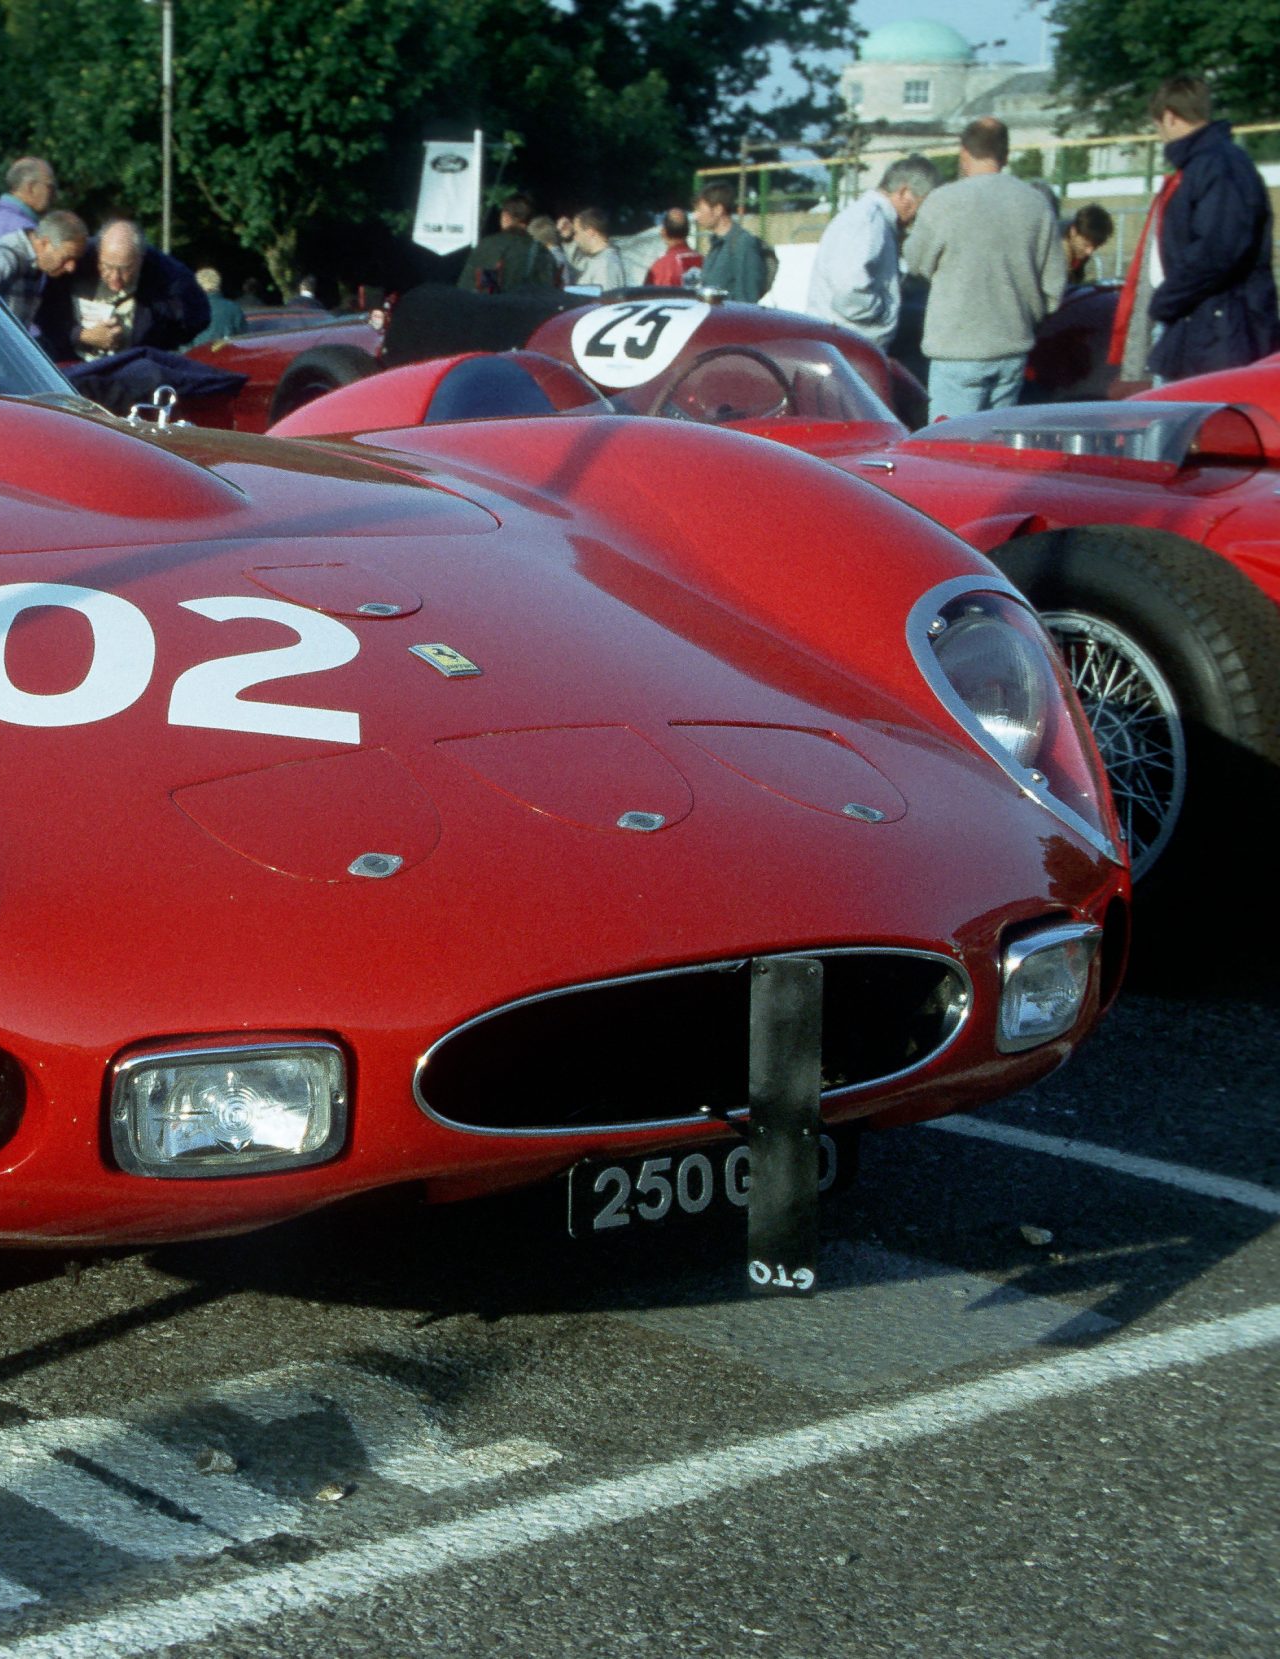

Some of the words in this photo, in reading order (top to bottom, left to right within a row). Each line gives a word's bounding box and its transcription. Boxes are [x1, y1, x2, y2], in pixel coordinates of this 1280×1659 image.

[584, 305, 691, 360] 25
[593, 1153, 713, 1230] 250
[749, 1260, 814, 1290] GTO
